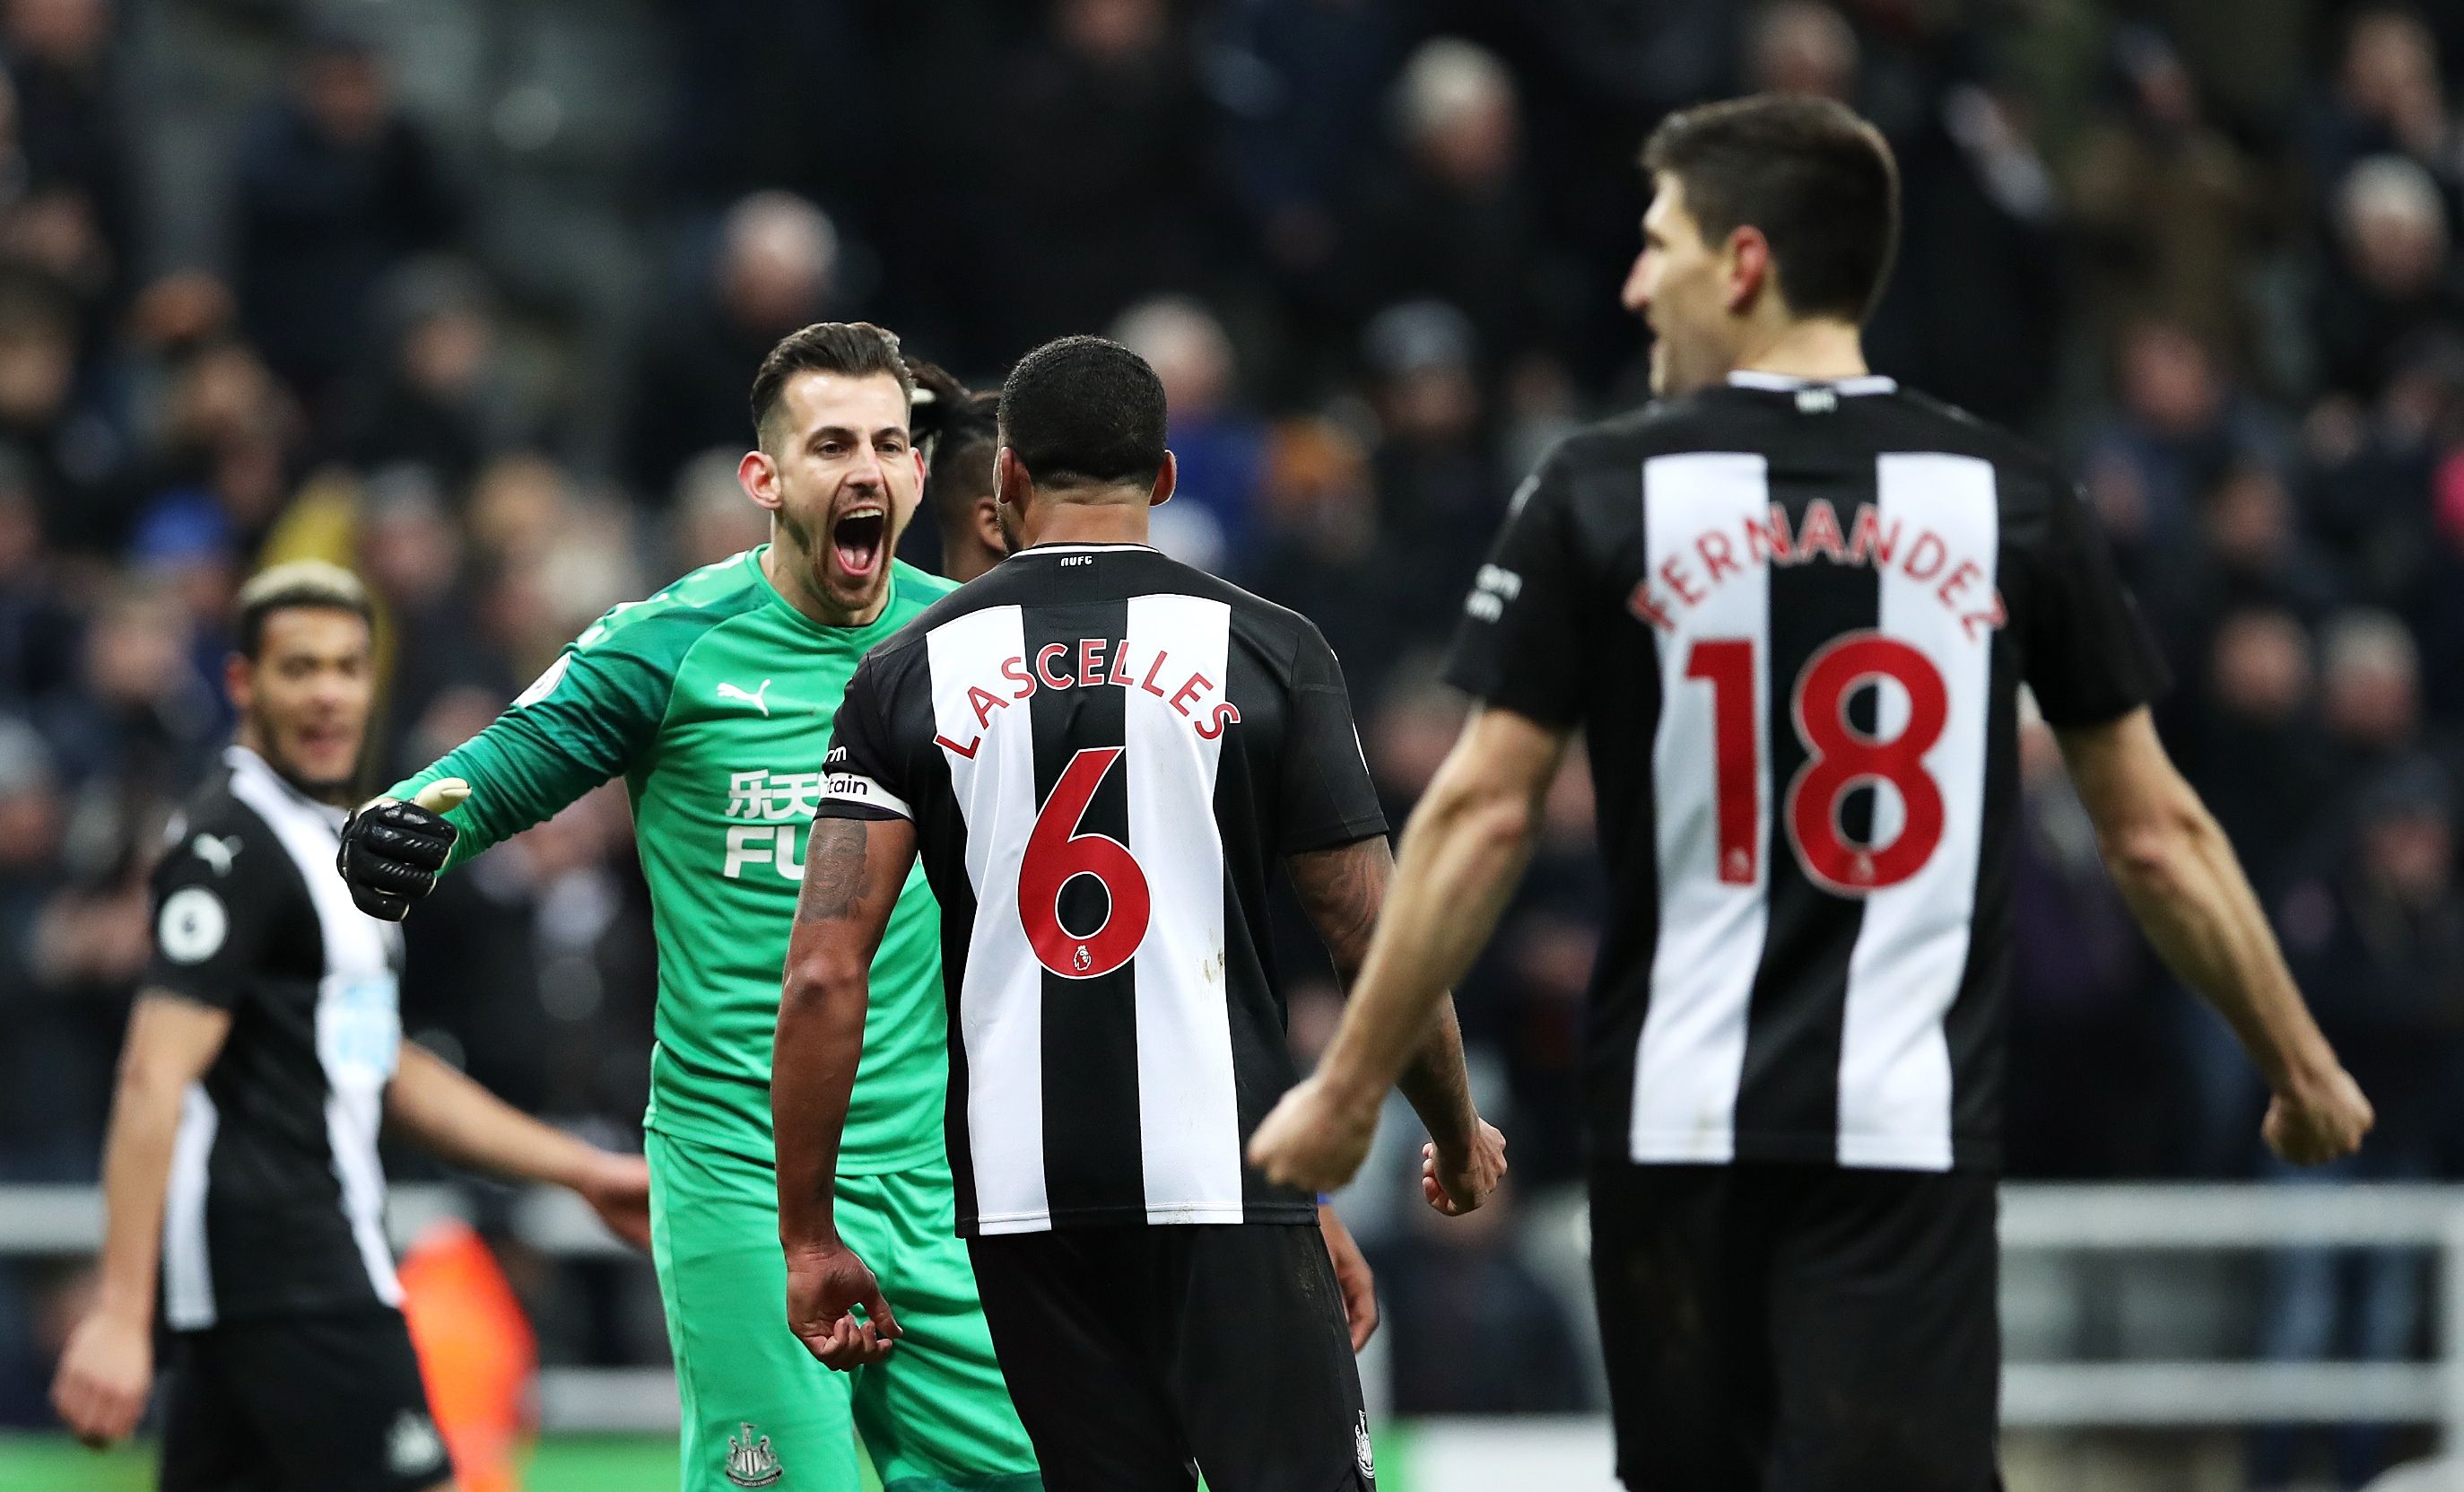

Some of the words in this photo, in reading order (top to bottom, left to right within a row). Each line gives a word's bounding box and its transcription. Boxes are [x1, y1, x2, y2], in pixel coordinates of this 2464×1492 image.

[1060, 555, 1093, 567] NUFC
[1626, 498, 2008, 644] FERNANDEZ
[933, 638, 1241, 760] LASCELLES
[1684, 629, 1950, 892] 18
[724, 769, 829, 820] 乐天
[1017, 746, 1151, 980] 6
